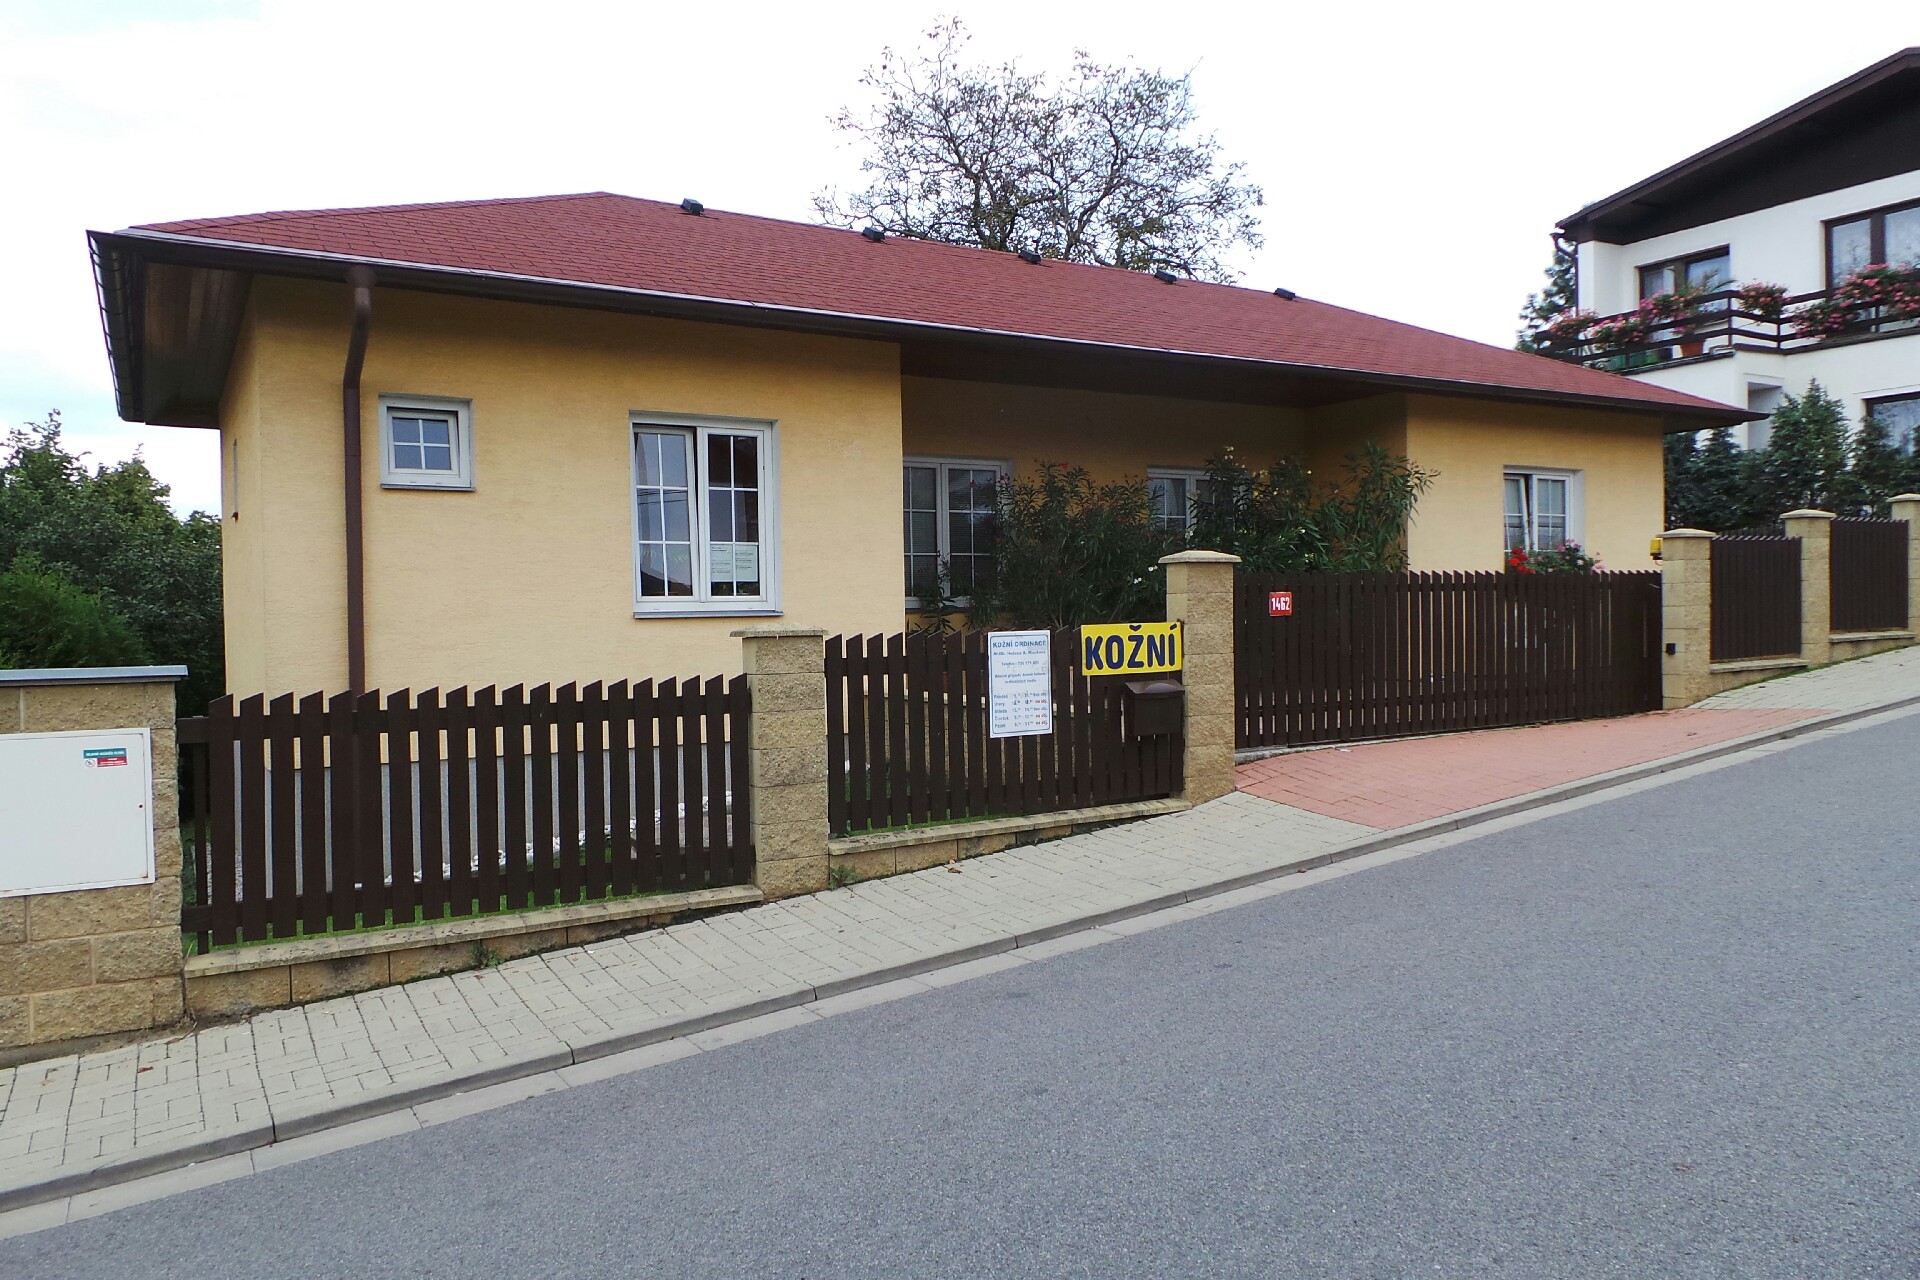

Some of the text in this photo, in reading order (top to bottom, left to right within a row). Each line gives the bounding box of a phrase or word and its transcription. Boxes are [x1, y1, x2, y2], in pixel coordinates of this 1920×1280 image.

[1271, 597, 1290, 611] 1462
[992, 640, 1013, 648] KOŽNÍ
[1085, 623, 1178, 670] KOŽNÍ
